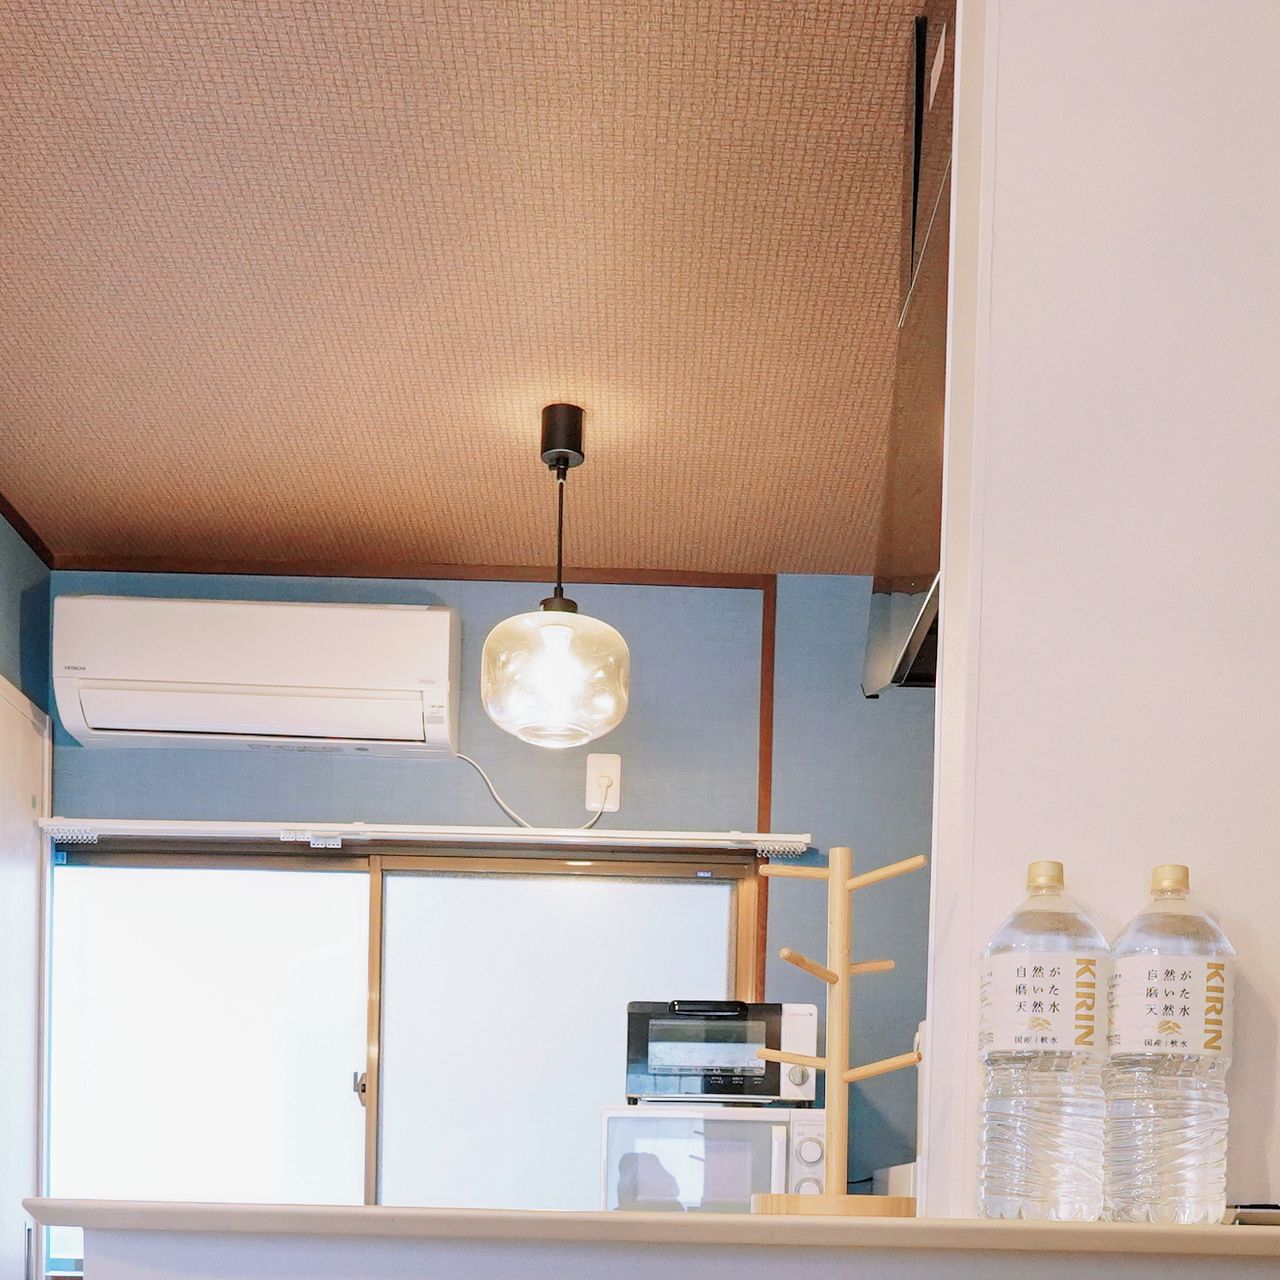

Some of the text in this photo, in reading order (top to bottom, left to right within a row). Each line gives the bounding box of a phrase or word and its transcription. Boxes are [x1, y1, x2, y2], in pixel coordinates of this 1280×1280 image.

[1016, 966, 1060, 978] 自然が
[1148, 969, 1192, 981] 自然が
[1015, 983, 1060, 996] 磨いた
[1016, 1001, 1060, 1013] 天然水
[1074, 958, 1096, 1046] KIRIN
[1204, 962, 1225, 1051] KIRIN
[1145, 1004, 1190, 1016] 天然水
